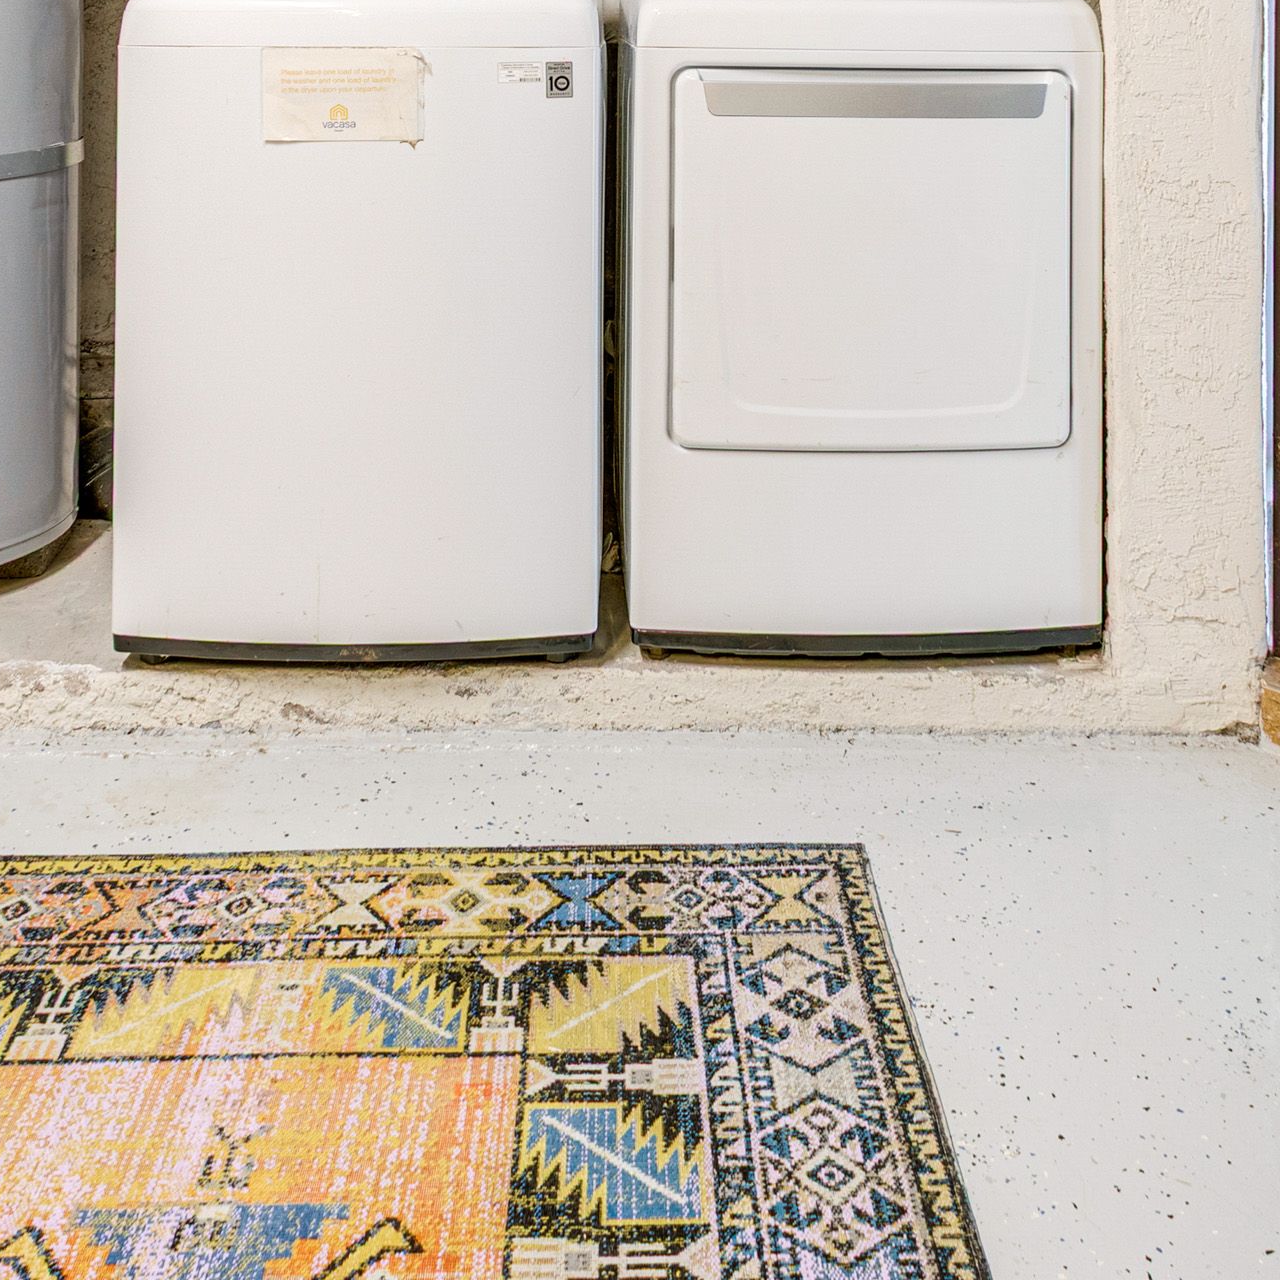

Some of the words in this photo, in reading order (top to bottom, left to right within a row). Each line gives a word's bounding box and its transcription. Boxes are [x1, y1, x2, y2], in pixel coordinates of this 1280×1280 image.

[361, 68, 386, 76] laundry
[549, 75, 570, 91] 10
[301, 86, 317, 94] dryer
[338, 86, 353, 94] your
[322, 121, 357, 129] vacasa
